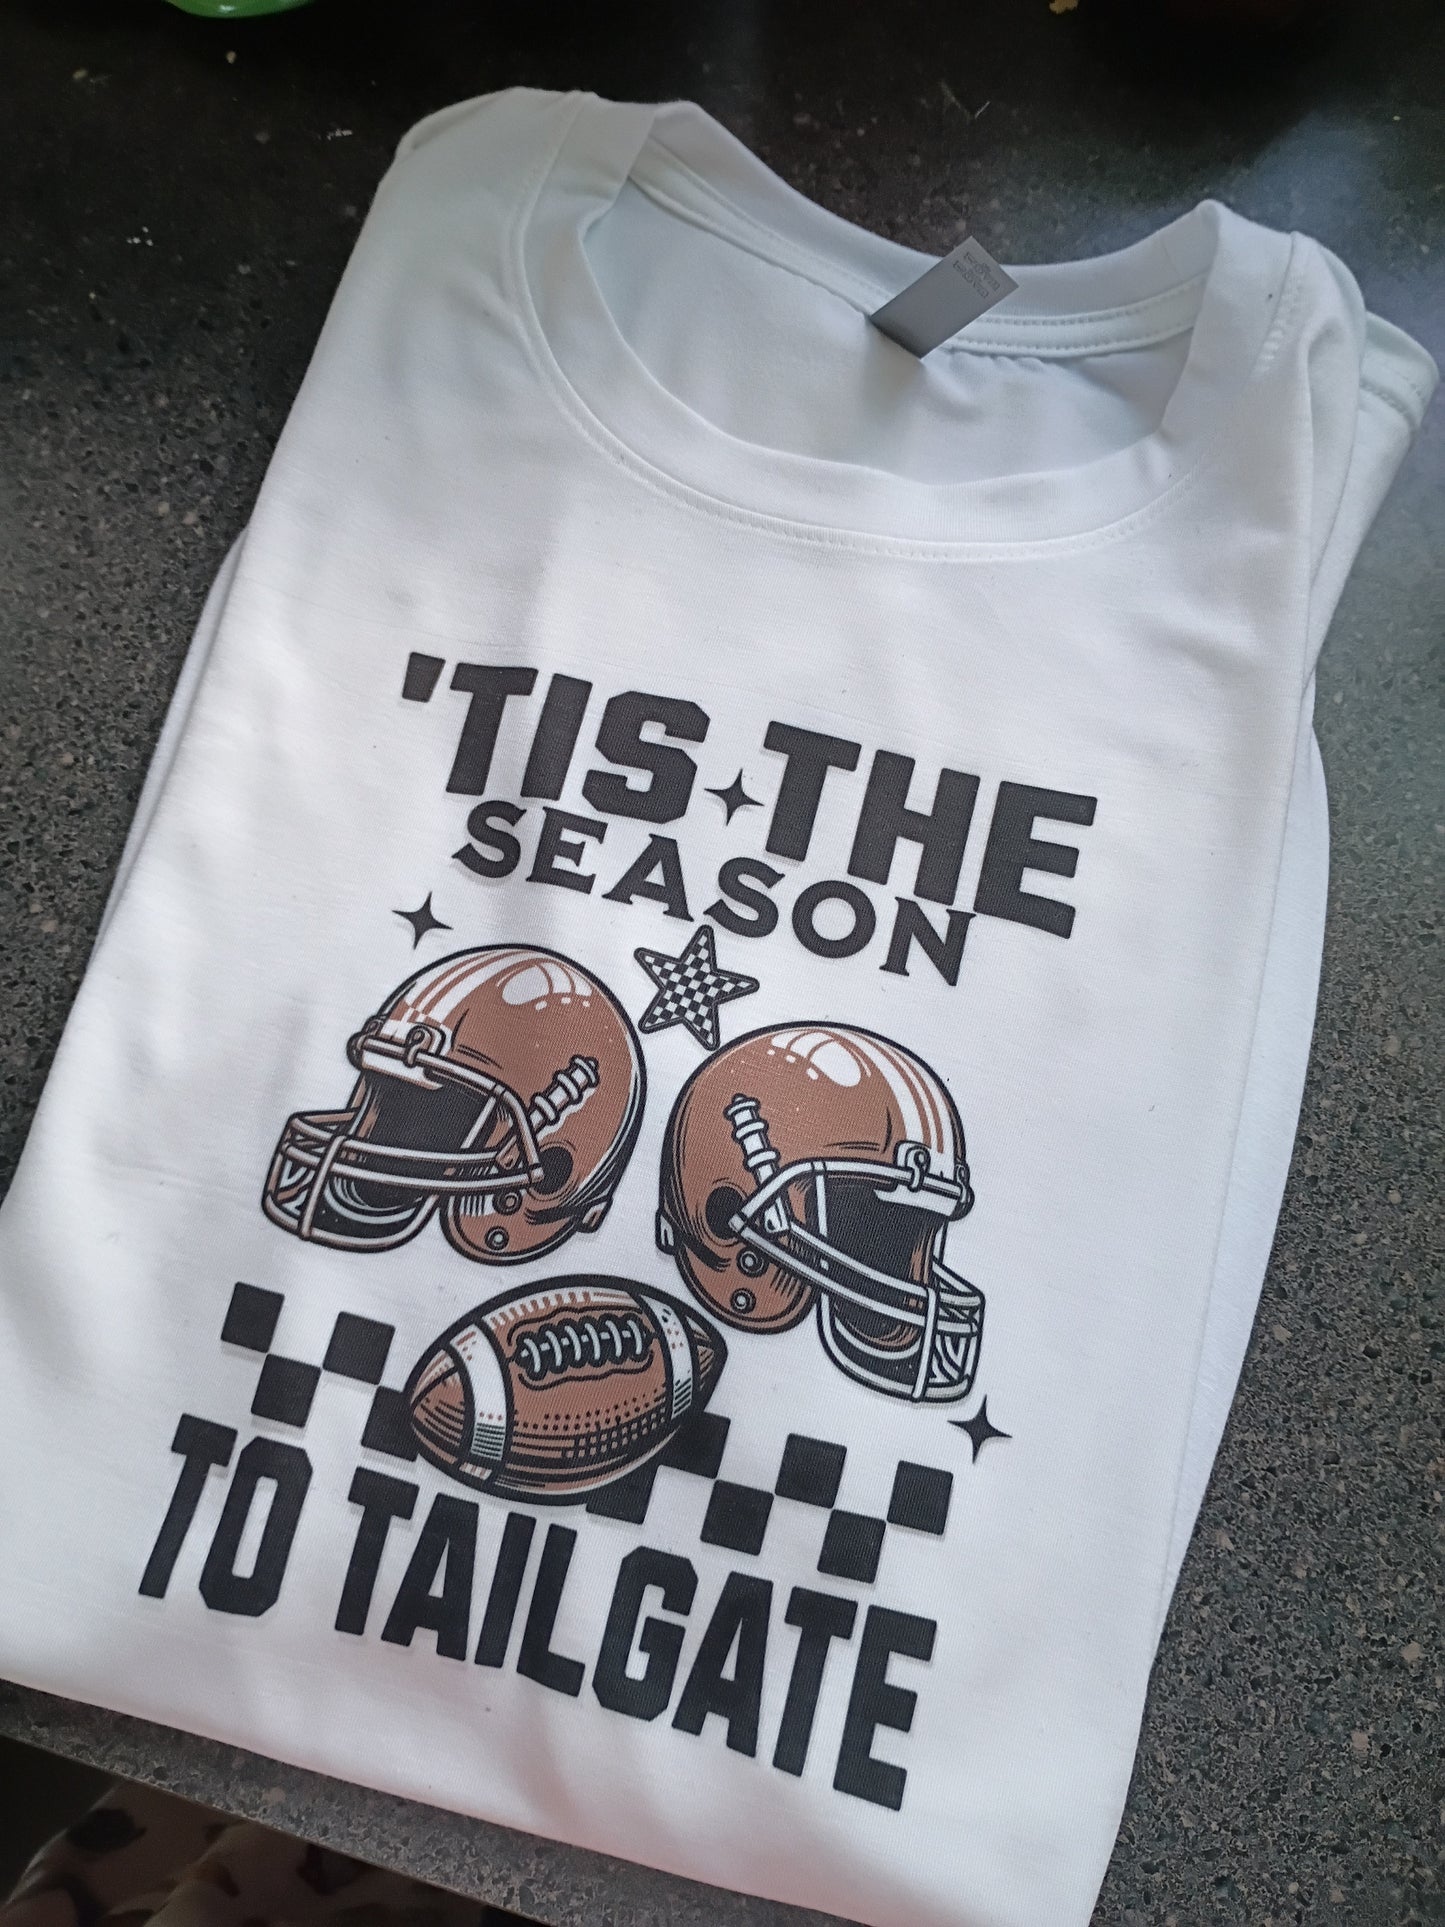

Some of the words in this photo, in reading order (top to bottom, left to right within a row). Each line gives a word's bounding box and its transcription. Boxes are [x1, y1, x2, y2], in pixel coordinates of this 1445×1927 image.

[401, 652, 711, 825] 'TIS
[763, 720, 1098, 940] THE
[451, 799, 977, 987] SEASON
[137, 1412, 313, 1618] TO
[334, 1465, 938, 1812] TAILGATE
